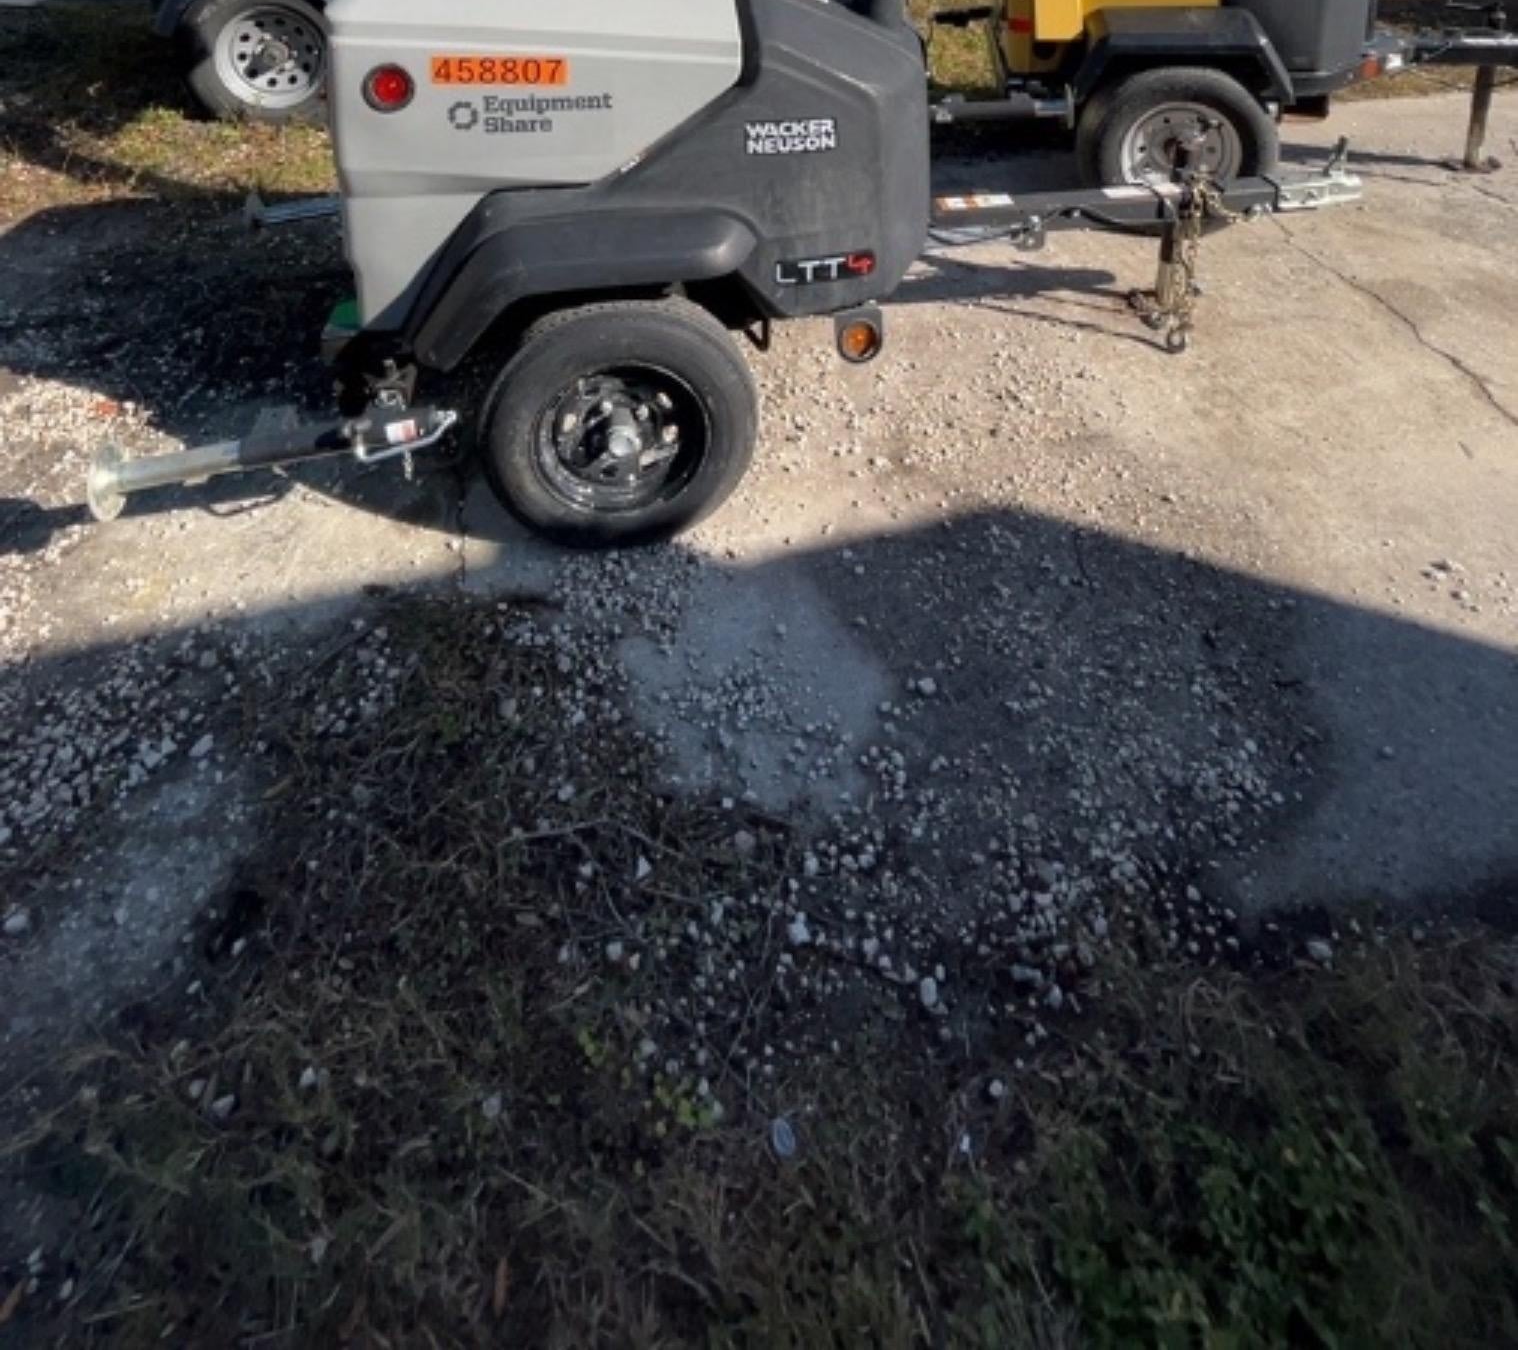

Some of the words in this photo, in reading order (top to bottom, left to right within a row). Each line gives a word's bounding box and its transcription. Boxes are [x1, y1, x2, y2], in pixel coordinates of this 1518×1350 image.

[433, 58, 563, 85] 458807
[482, 93, 613, 117] Equipment
[484, 116, 553, 133] Share
[746, 119, 834, 137] WACKER
[747, 134, 836, 154] NEUSON
